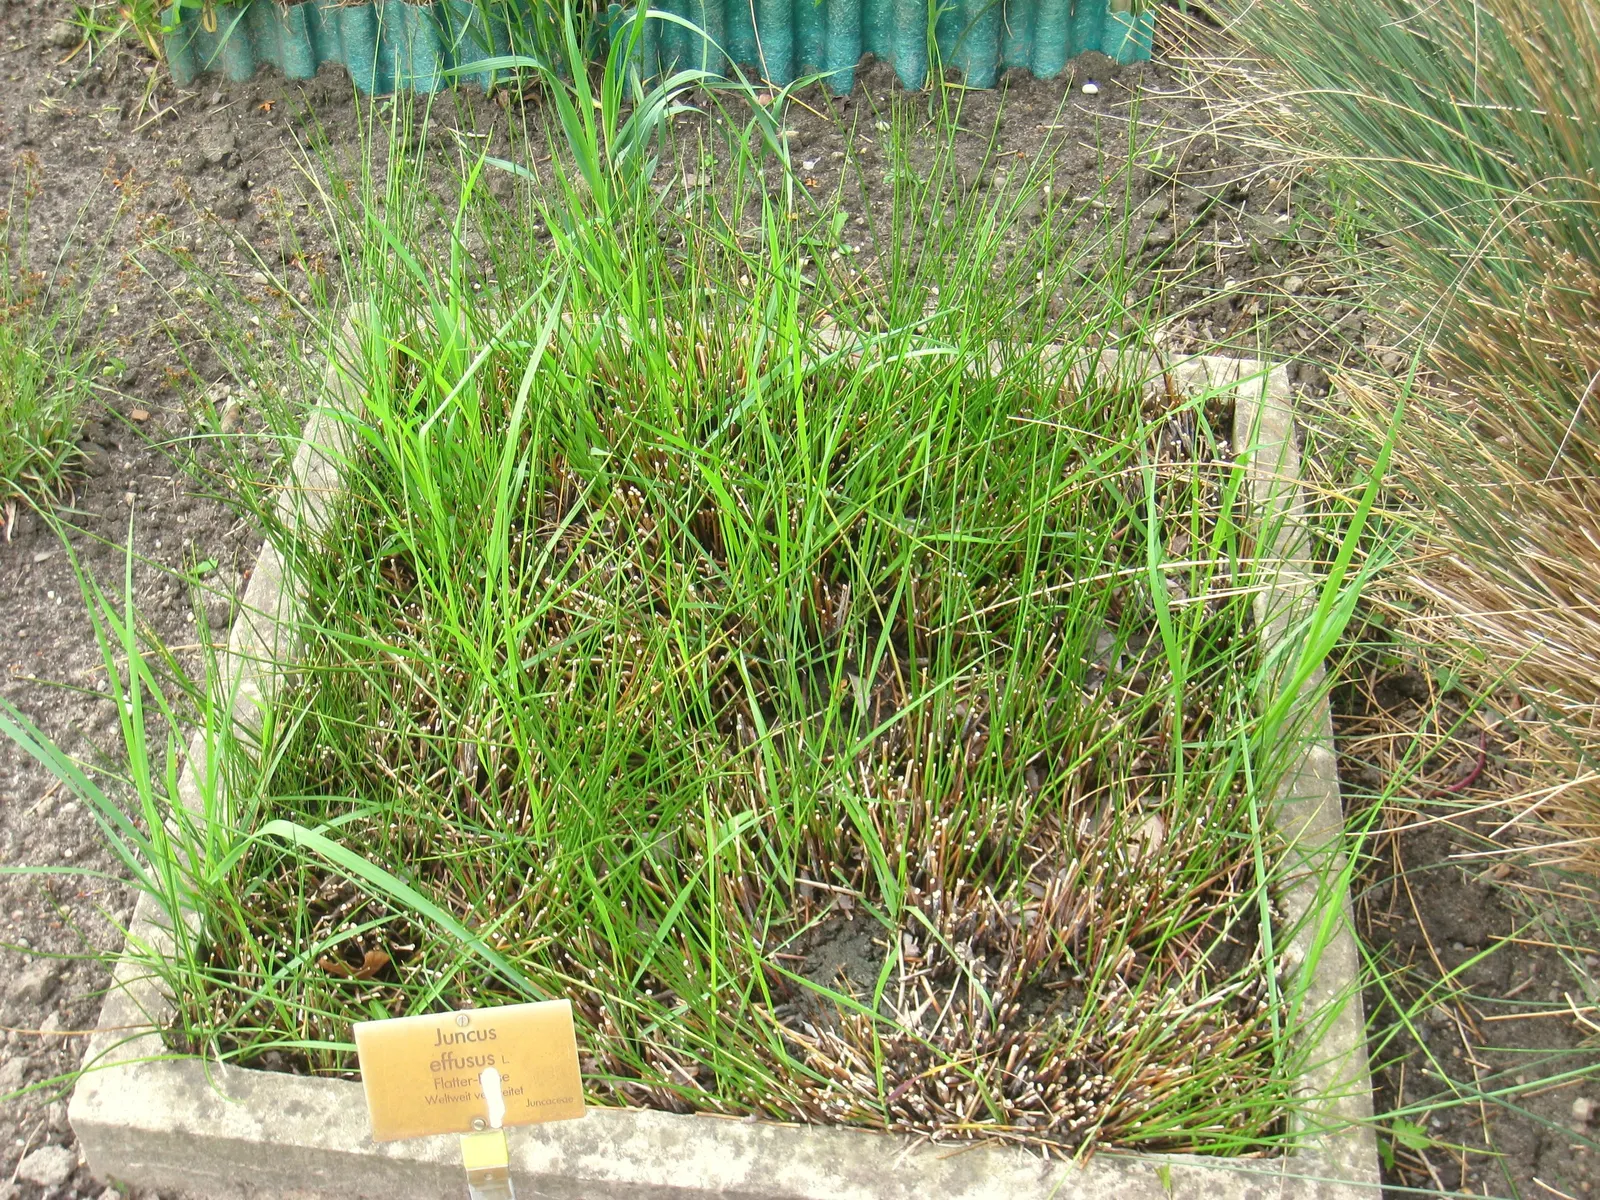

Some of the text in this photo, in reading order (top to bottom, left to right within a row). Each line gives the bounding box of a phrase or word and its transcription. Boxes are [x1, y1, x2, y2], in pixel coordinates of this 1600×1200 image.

[434, 1028, 497, 1047] Juncus
[429, 1051, 496, 1072] effusus
[433, 1073, 510, 1090] Flatter-e
[424, 1086, 524, 1105] Weltweit veeitet
[526, 1097, 574, 1107] Juncaceae
